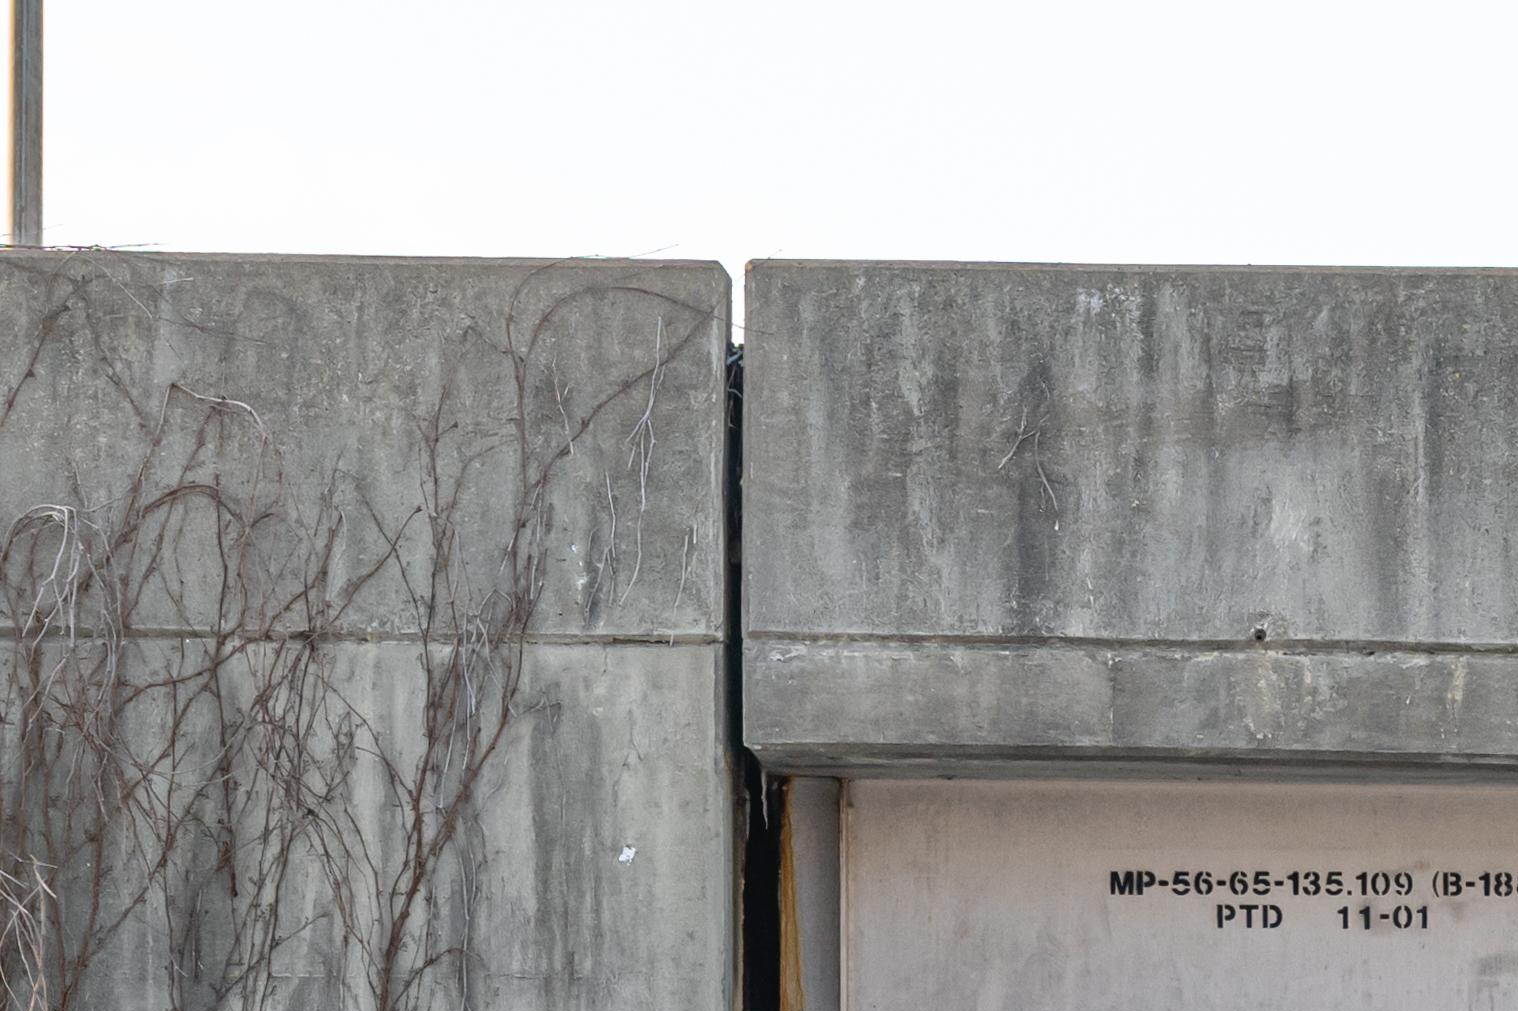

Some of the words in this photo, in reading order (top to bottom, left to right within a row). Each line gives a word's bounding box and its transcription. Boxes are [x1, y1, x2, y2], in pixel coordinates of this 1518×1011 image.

[1109, 870, 1413, 896] MP-56-65-135.109
[1215, 904, 1283, 930] PTD
[1337, 904, 1429, 931] 11-01
